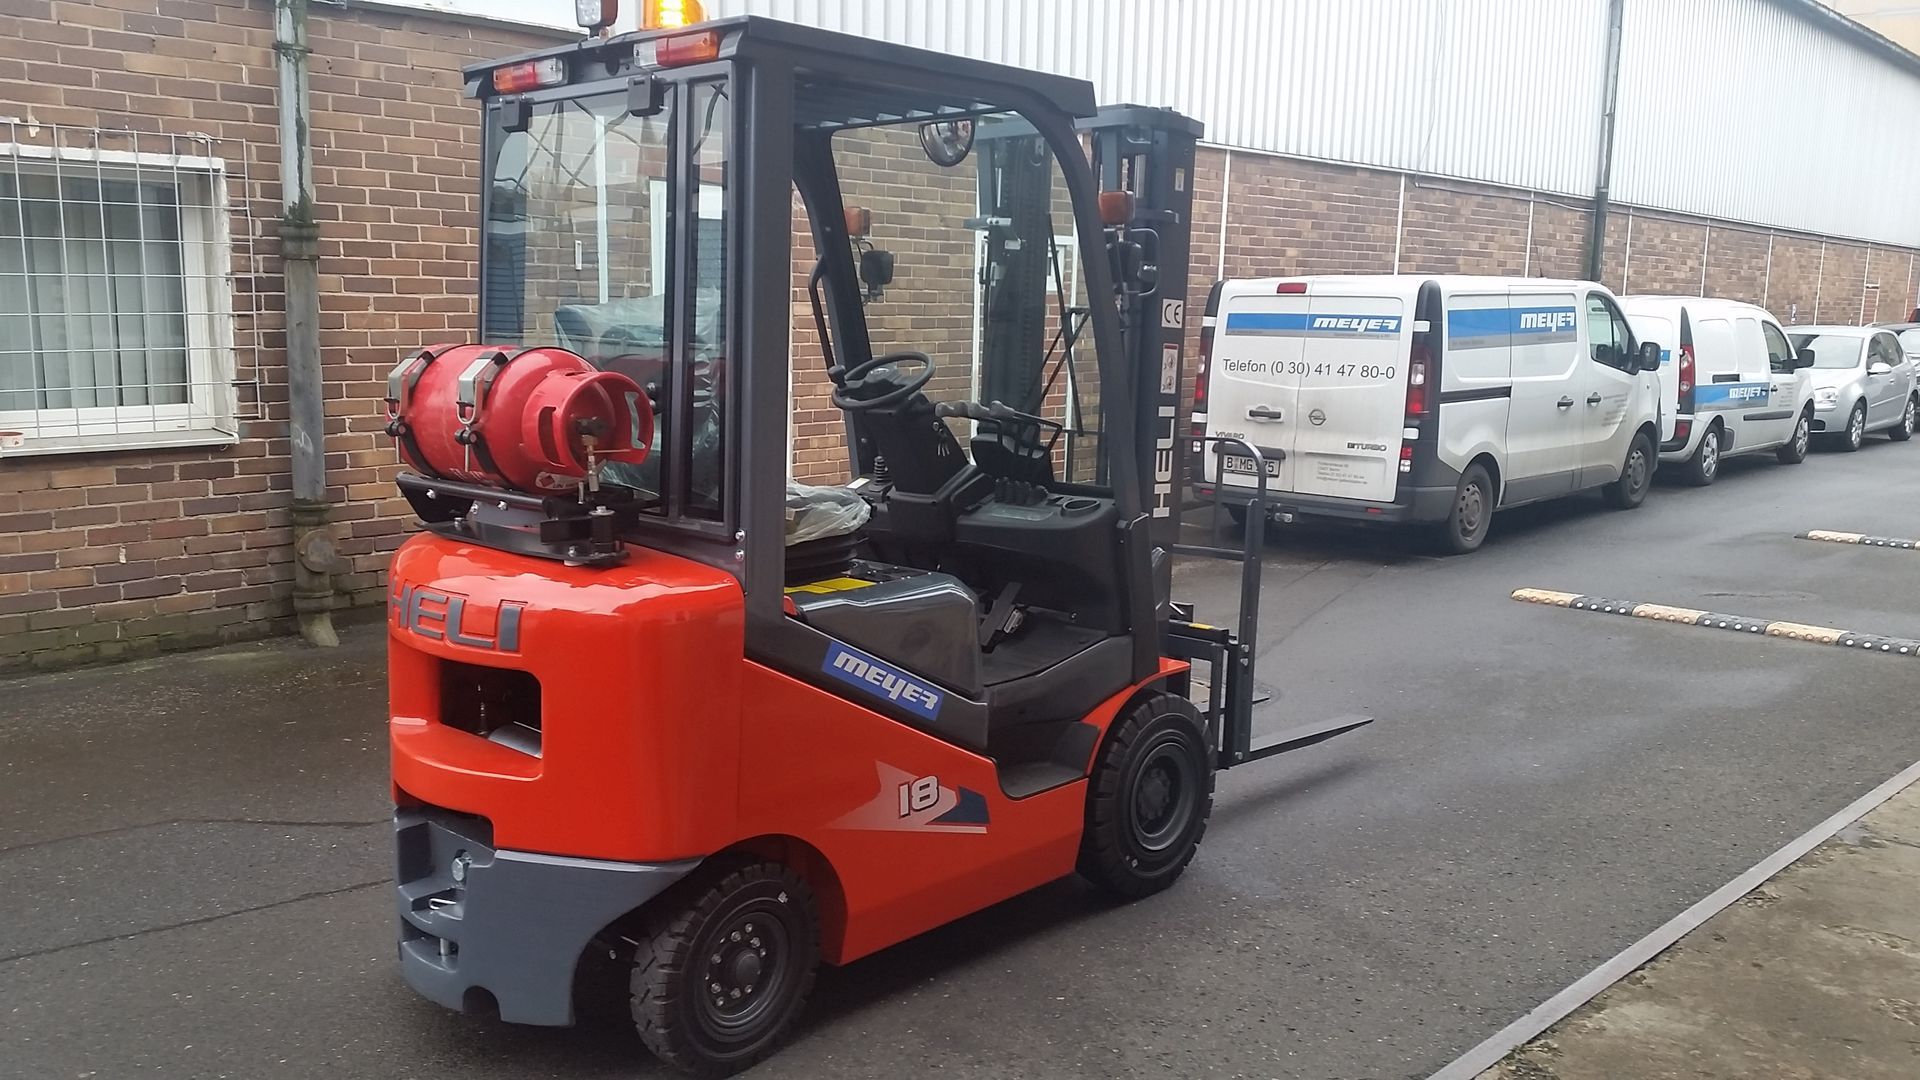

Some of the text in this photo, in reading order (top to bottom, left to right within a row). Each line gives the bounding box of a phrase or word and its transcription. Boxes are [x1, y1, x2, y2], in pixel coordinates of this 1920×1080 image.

[1223, 358, 1395, 379] Telefon (0 30) 41 47 80-0
[1153, 406, 1175, 518] HELI
[1226, 456, 1233, 468] B
[1239, 458, 1253, 470] MG
[390, 579, 524, 652] HELI
[899, 775, 939, 818] 18
